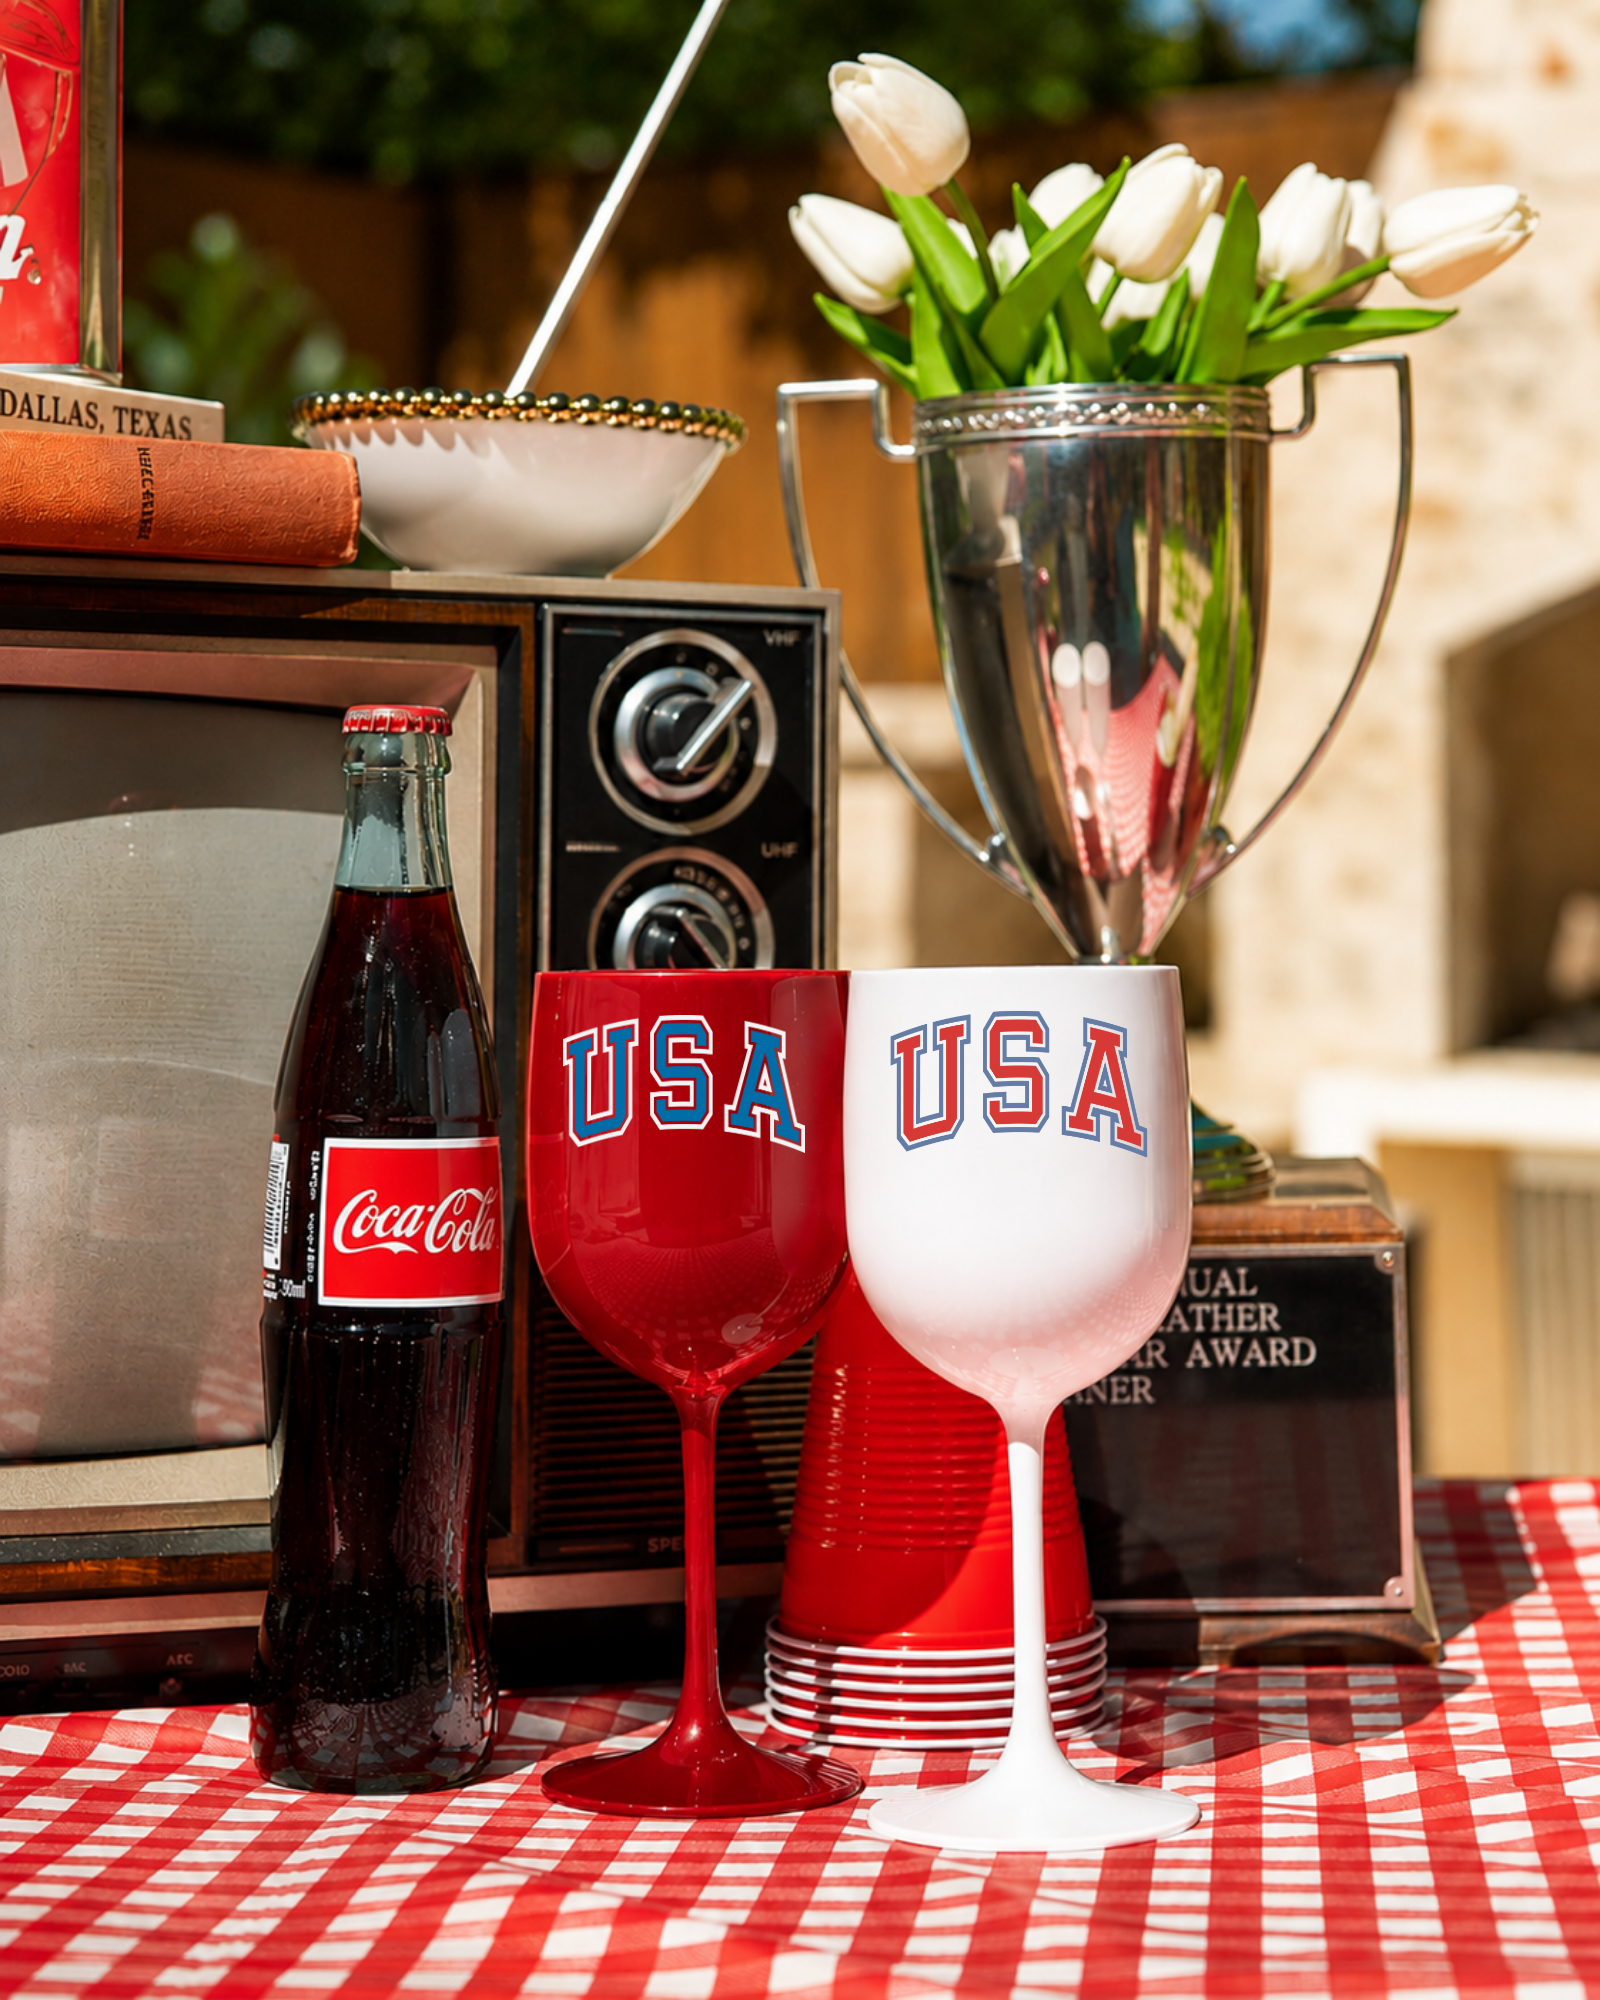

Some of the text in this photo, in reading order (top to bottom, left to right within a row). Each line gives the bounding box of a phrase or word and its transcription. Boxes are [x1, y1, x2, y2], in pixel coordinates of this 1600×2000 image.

[0, 388, 192, 441] DALLAS, TEXAS
[763, 628, 799, 646] VHF
[761, 842, 798, 858] UHF
[563, 1014, 806, 1153] USA
[891, 1010, 1148, 1157] USA
[333, 1187, 498, 1254] Coca-Cola
[1158, 1301, 1282, 1332] ATHER
[1186, 1337, 1317, 1368] AWARD
[1063, 1376, 1155, 1404] NER
[647, 1536, 686, 1552] SPE
